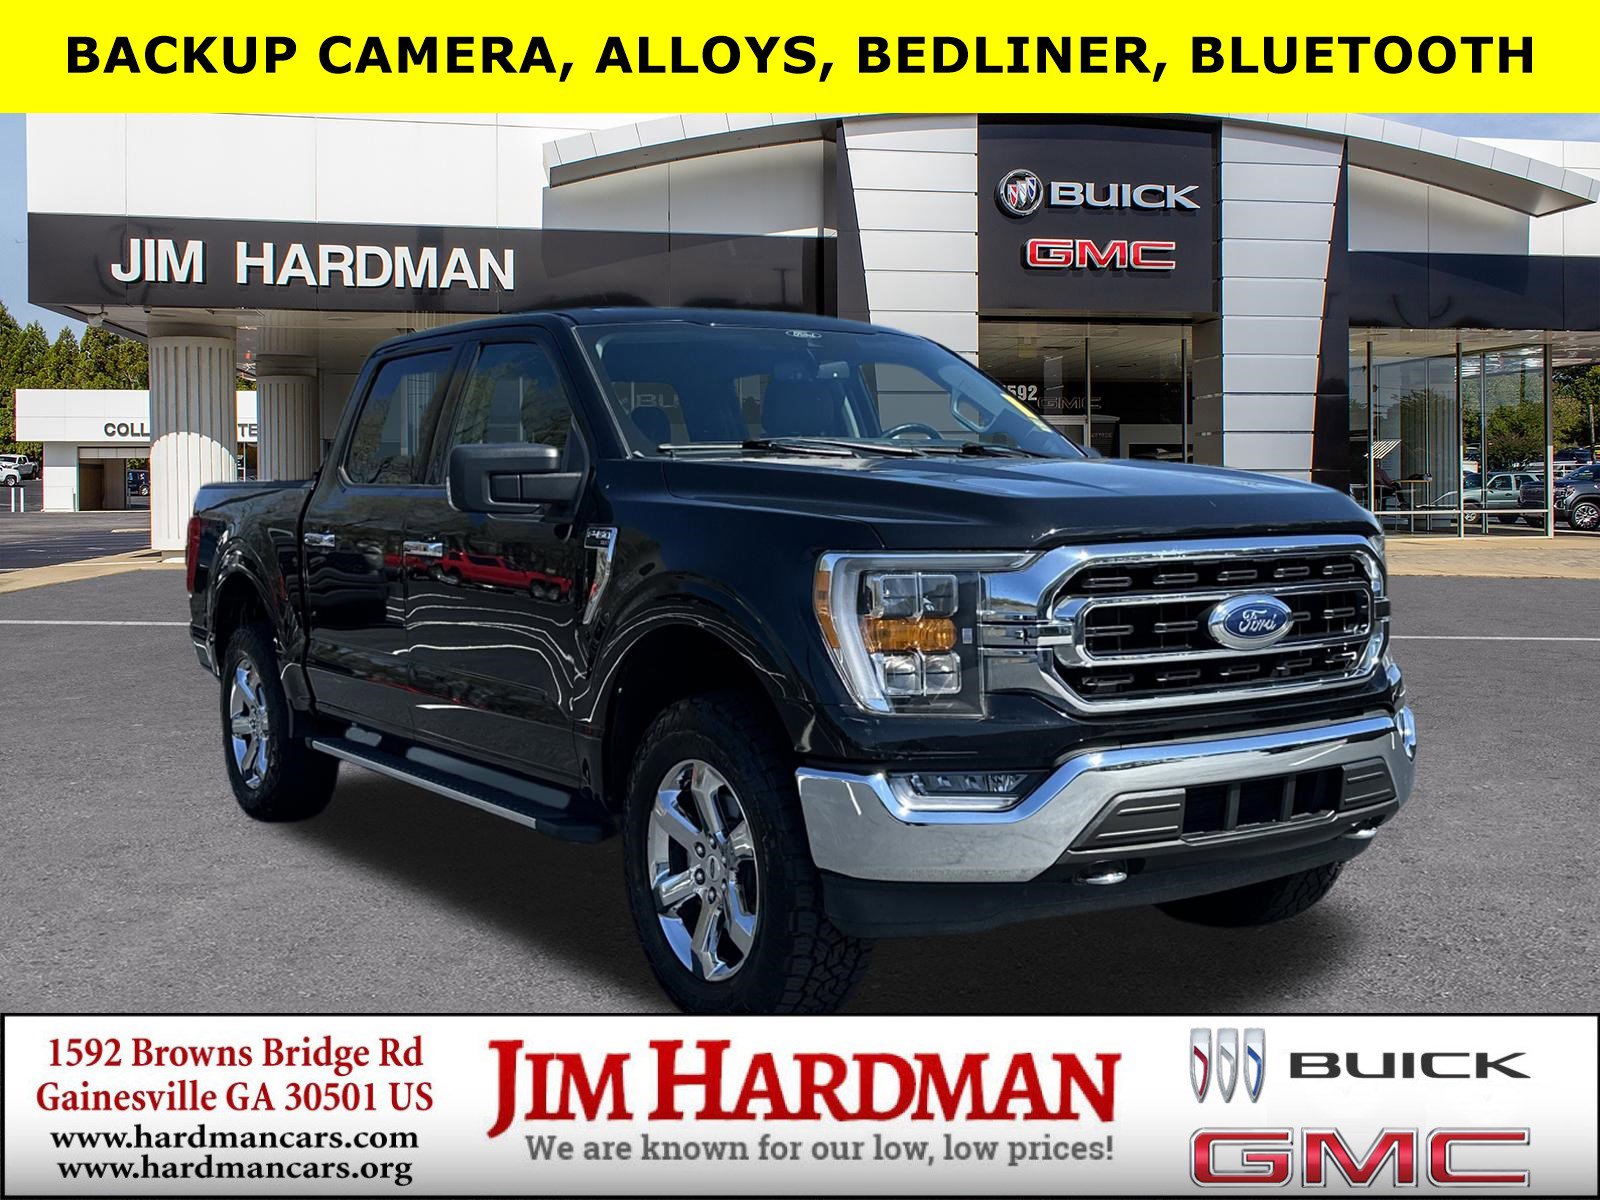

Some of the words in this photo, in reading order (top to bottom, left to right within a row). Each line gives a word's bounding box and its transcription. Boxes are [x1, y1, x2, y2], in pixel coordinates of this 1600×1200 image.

[1051, 181, 1200, 209] BUICK
[111, 238, 204, 283] JIM
[236, 241, 514, 290] HARDMAN
[1027, 238, 1176, 269] GMC
[1238, 608, 1278, 633] Ford
